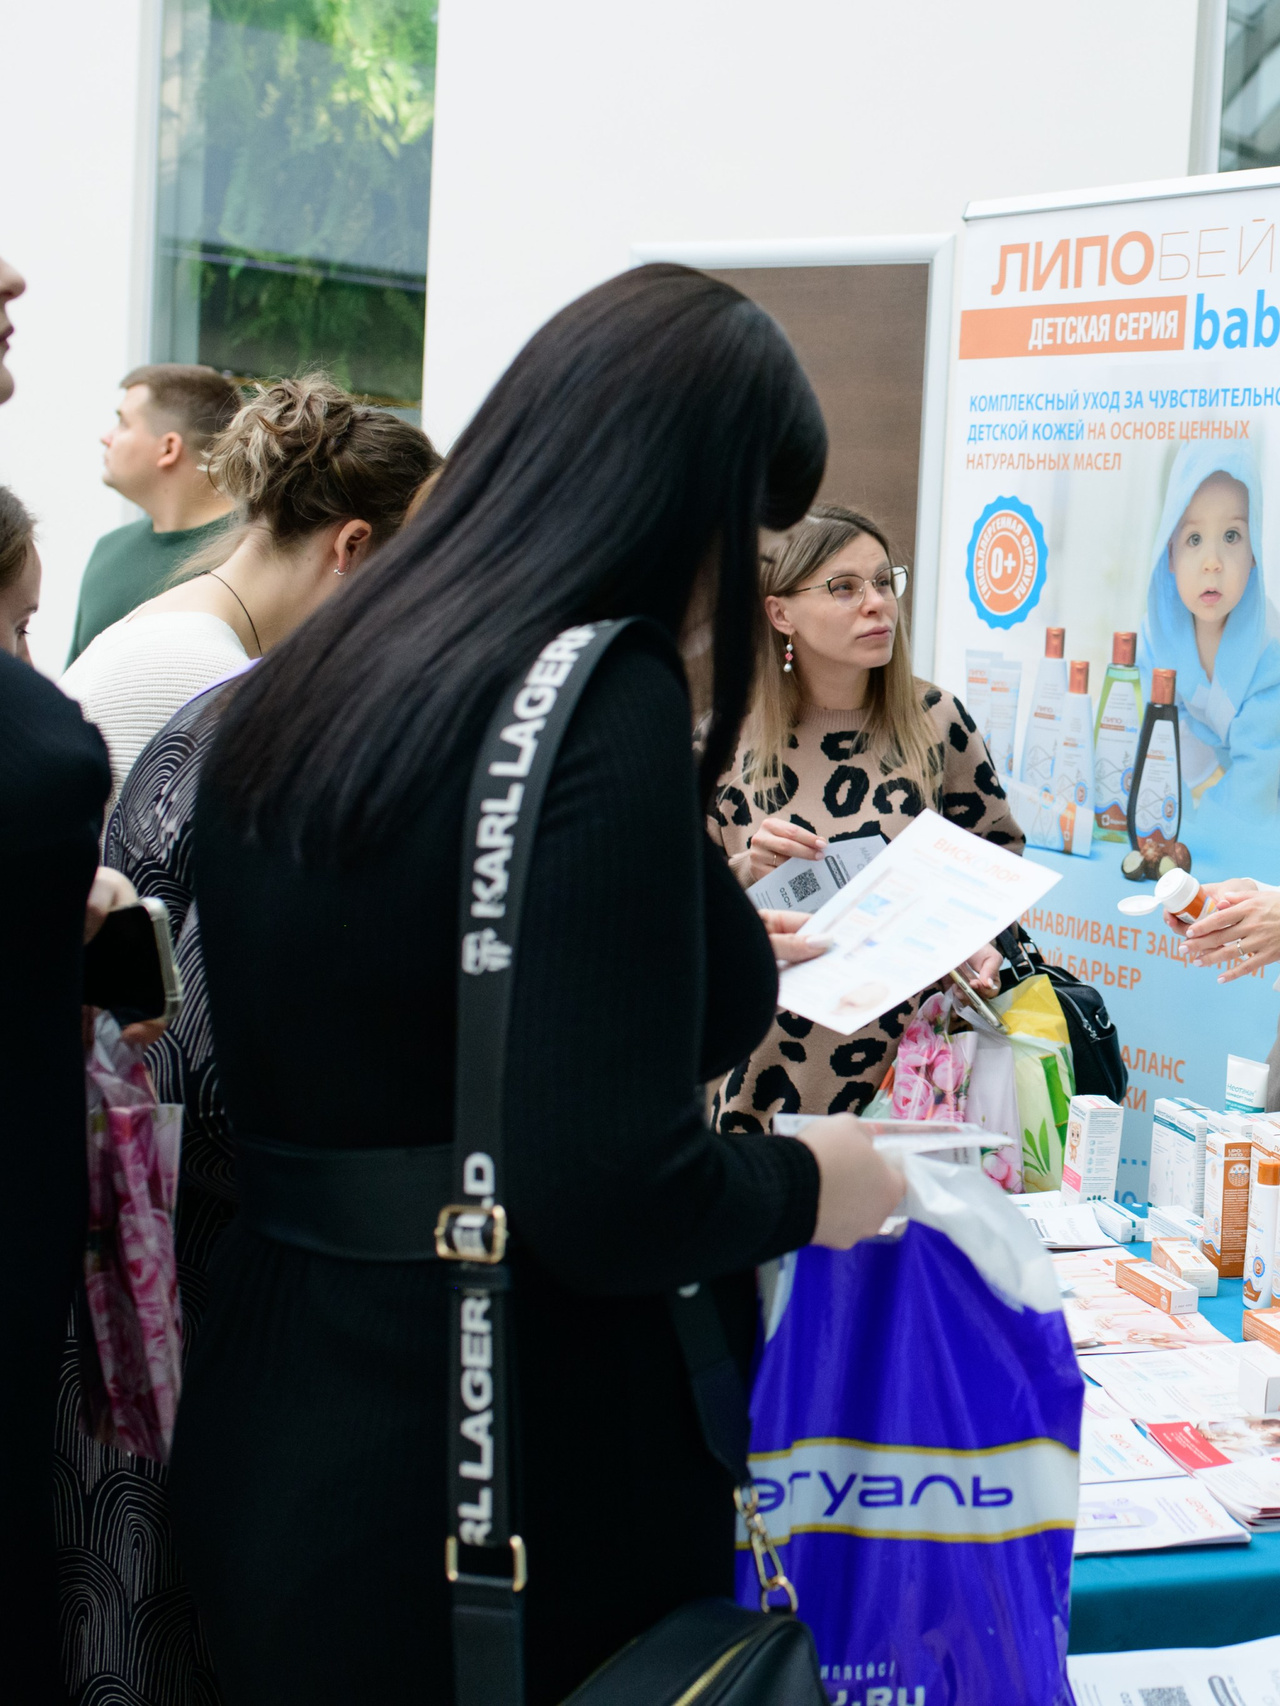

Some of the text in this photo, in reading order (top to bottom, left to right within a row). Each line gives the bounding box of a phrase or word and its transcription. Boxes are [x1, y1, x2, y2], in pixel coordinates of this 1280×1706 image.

[1028, 310, 1178, 350] ДЕТСКАЯ СЕРИЯ
[969, 389, 1079, 412] КОМПЛЕКСНЫЙ
[1083, 391, 1121, 412] УХОД
[1124, 390, 1144, 410] ЗА
[967, 419, 1250, 444] ДЕТСКОЙ КОЖЕЙ НА ОСНОВЕ ЦЕННЫХ
[966, 453, 1122, 471] НАТУРАЛЬНЫХ МАСЕЛ
[991, 547, 1016, 579] 0+
[1012, 534, 1034, 600] ФОРМУЛА
[470, 782, 525, 918] KARL
[1020, 908, 1141, 951] АНАВЛИВАЕТ
[1121, 1045, 1186, 1084] АЛАНС
[1121, 1086, 1147, 1112] КИ
